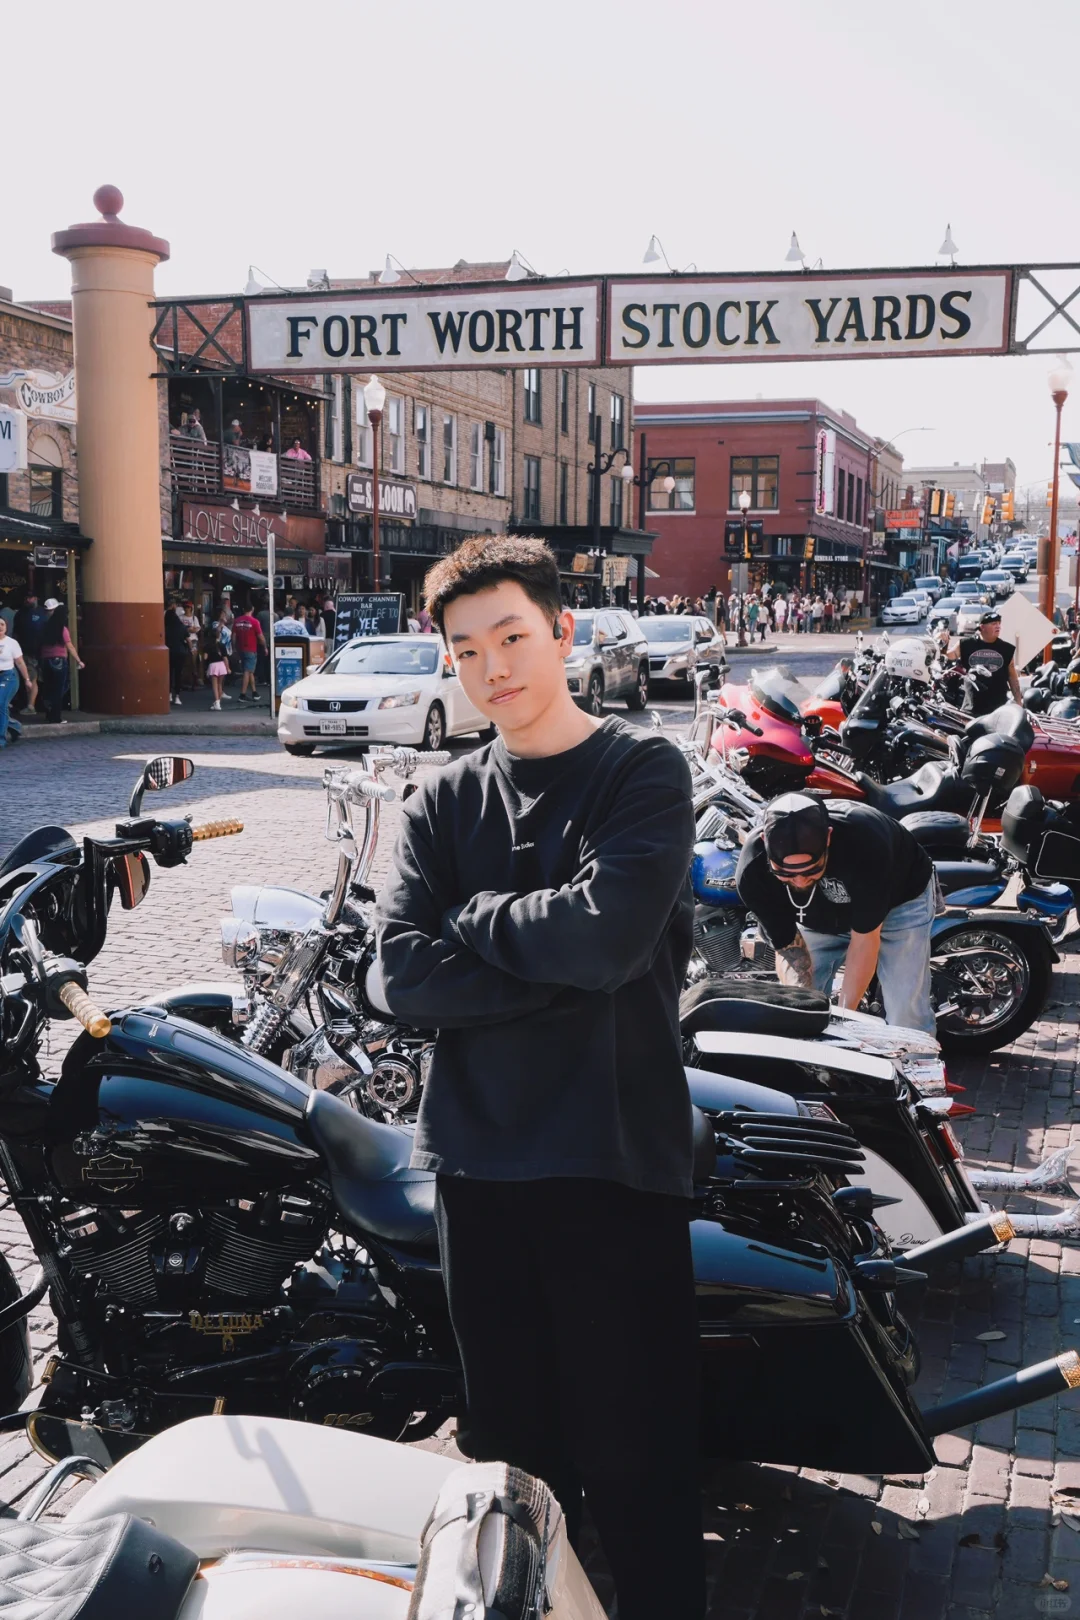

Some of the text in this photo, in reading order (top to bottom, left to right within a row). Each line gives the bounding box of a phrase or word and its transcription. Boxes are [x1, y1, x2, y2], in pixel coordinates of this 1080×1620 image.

[286, 306, 584, 358] FORT WORTH
[621, 290, 973, 349] STOCK YARDS
[20, 382, 65, 408] COWBOY
[365, 481, 404, 513] SLOON
[189, 510, 274, 545] LOVE SHACK
[359, 617, 380, 630] YEE
[323, 1412, 375, 1426] 114
